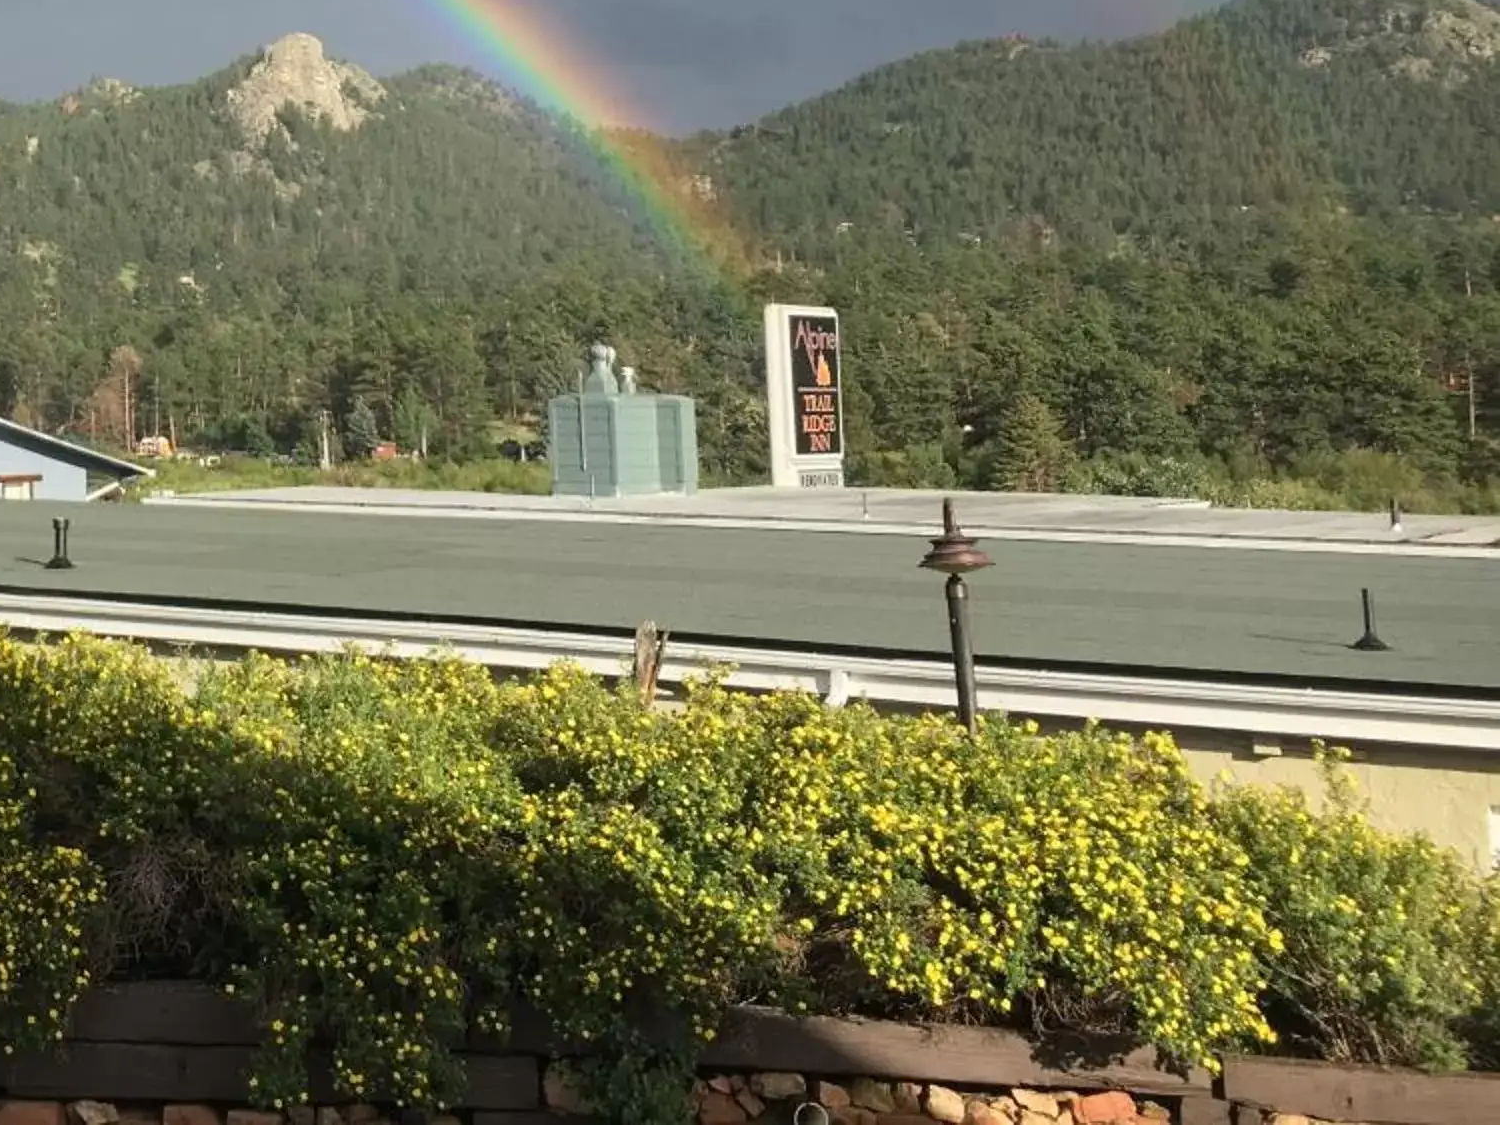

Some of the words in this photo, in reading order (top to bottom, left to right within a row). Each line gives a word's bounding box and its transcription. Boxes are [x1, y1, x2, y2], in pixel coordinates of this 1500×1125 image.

[795, 319, 836, 359] Alpine
[803, 394, 834, 412] TRAIL
[802, 415, 836, 433] RIDGE
[810, 433, 831, 451] INN
